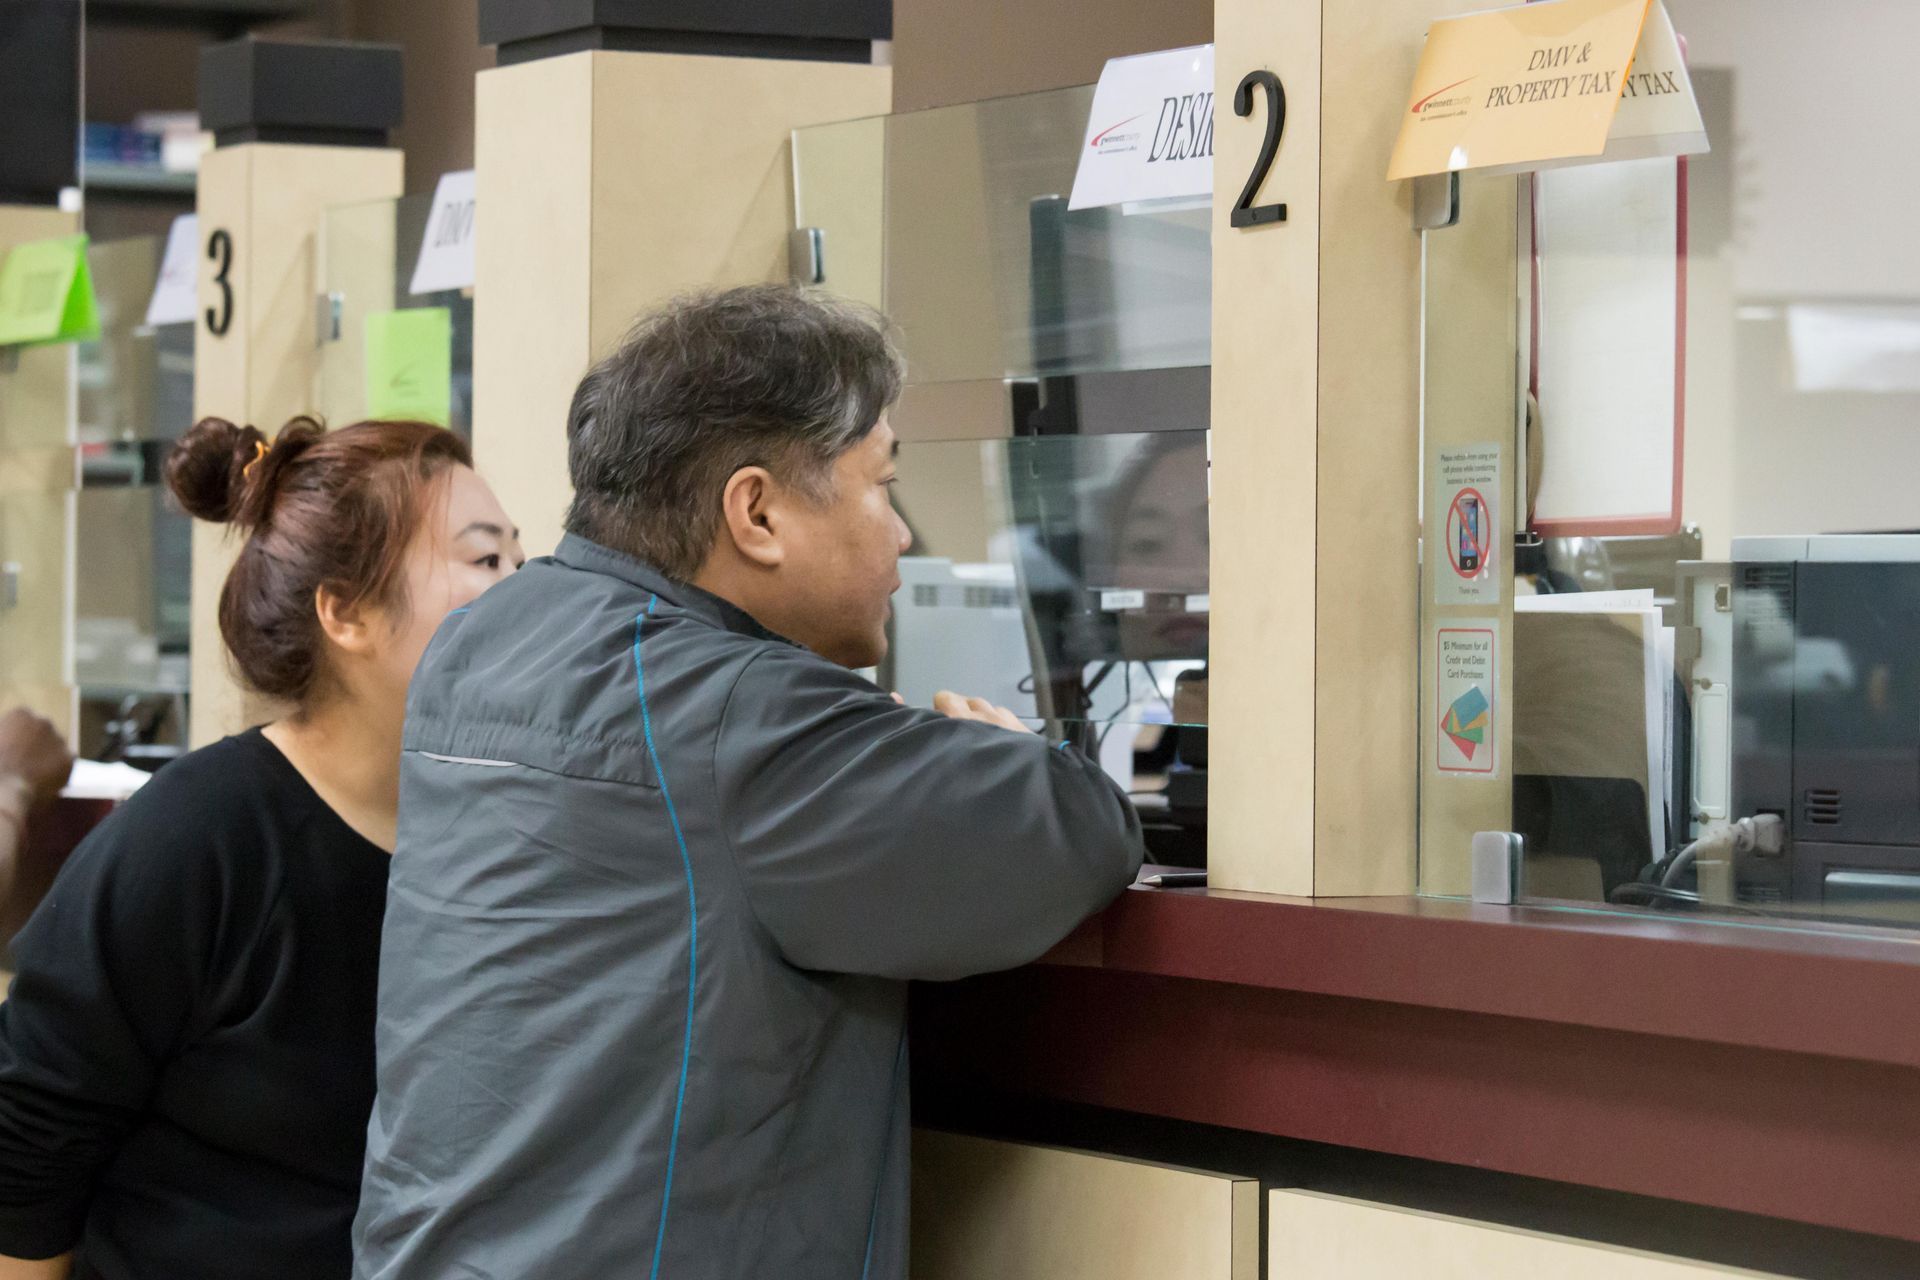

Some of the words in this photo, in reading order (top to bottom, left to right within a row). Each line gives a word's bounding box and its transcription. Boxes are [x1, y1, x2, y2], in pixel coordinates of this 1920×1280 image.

[1528, 44, 1577, 71] DMV
[1576, 41, 1592, 64] &
[1484, 76, 1576, 109] PROPERTY
[1578, 70, 1617, 96] TAX
[1639, 70, 1680, 96] TAX
[1231, 70, 1287, 227] 2
[207, 229, 234, 336] 3
[1445, 654, 1461, 664] Credit
[1450, 641, 1472, 650] Minimum
[1447, 668, 1459, 678] Card
